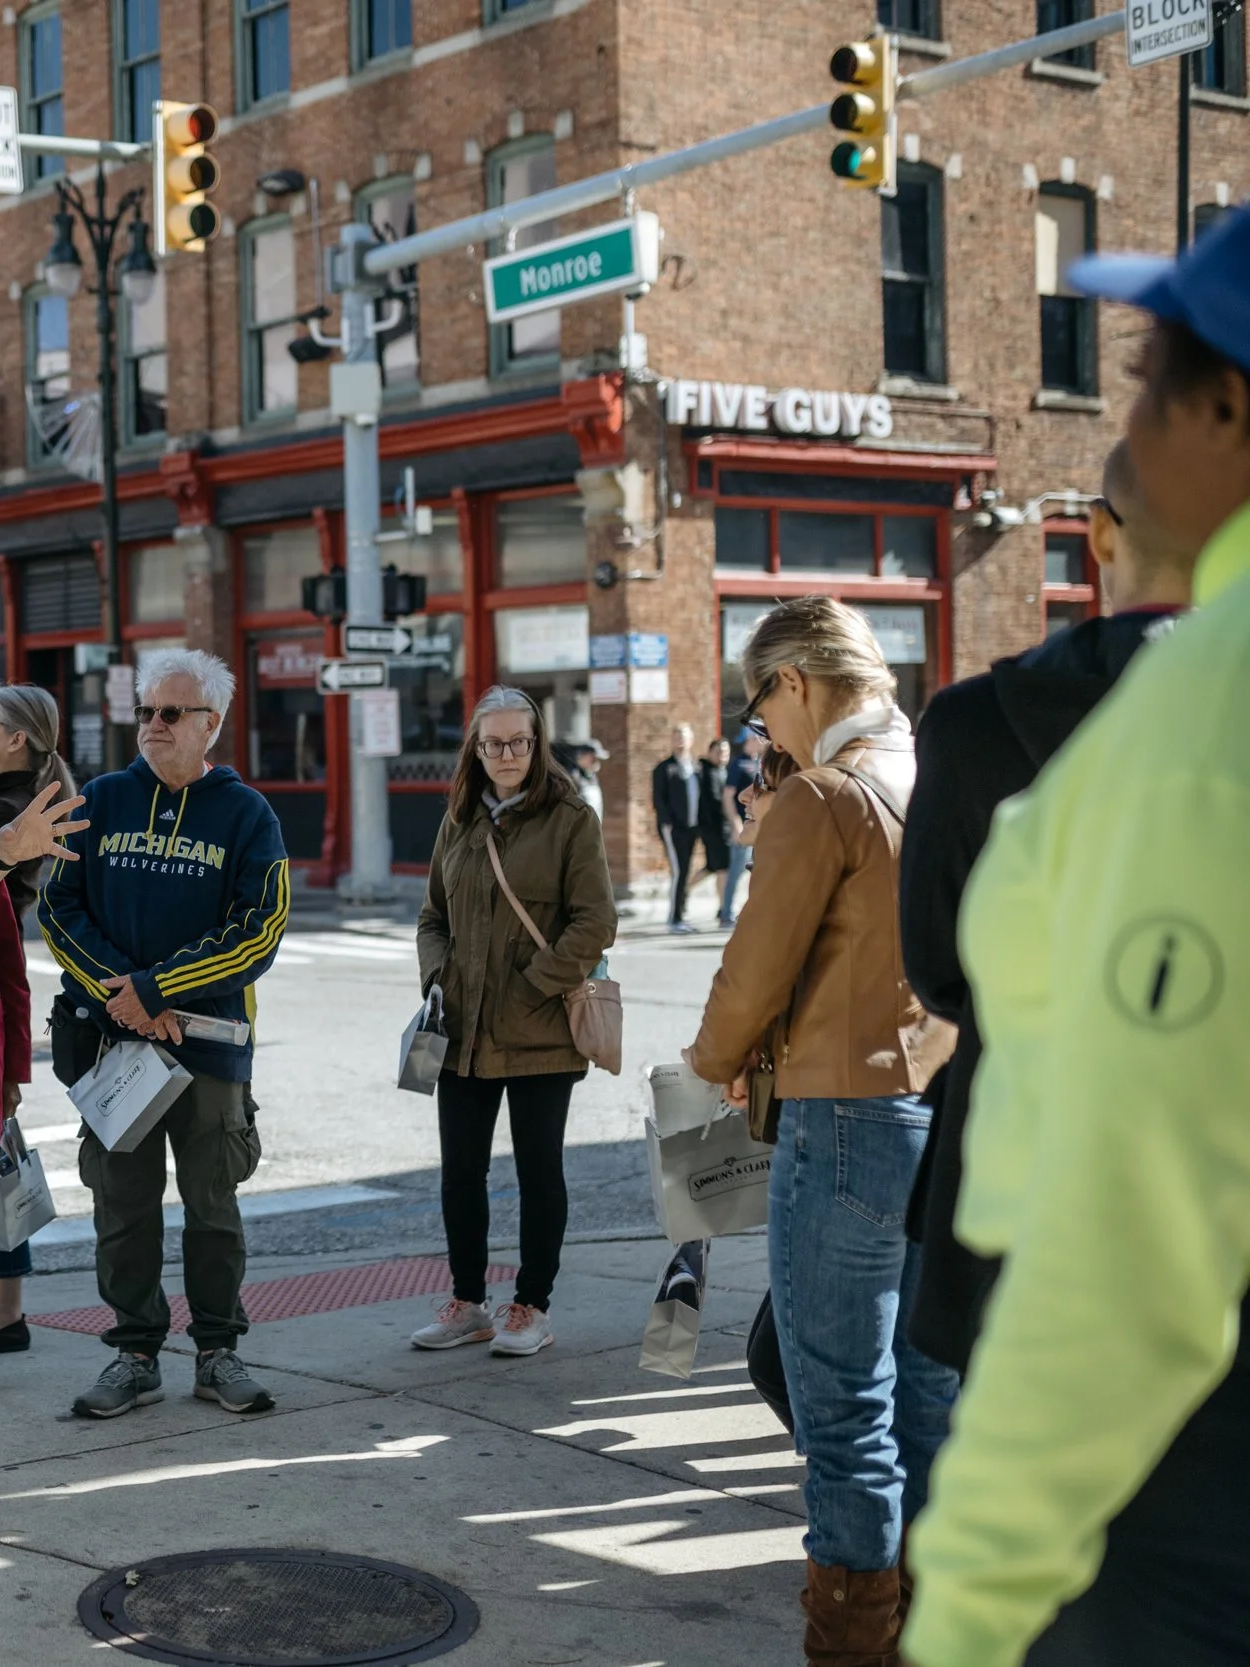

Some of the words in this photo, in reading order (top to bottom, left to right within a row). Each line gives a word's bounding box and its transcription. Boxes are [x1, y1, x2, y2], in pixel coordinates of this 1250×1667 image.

[1131, 19, 1206, 53] INTERSECTION
[519, 250, 603, 297] Monroe
[667, 379, 768, 429] FIVE
[773, 387, 893, 438] GUYS
[98, 832, 225, 870] MICHIGAN
[109, 856, 205, 877] WOLVERINES
[694, 1170, 735, 1192] SIMMONS
